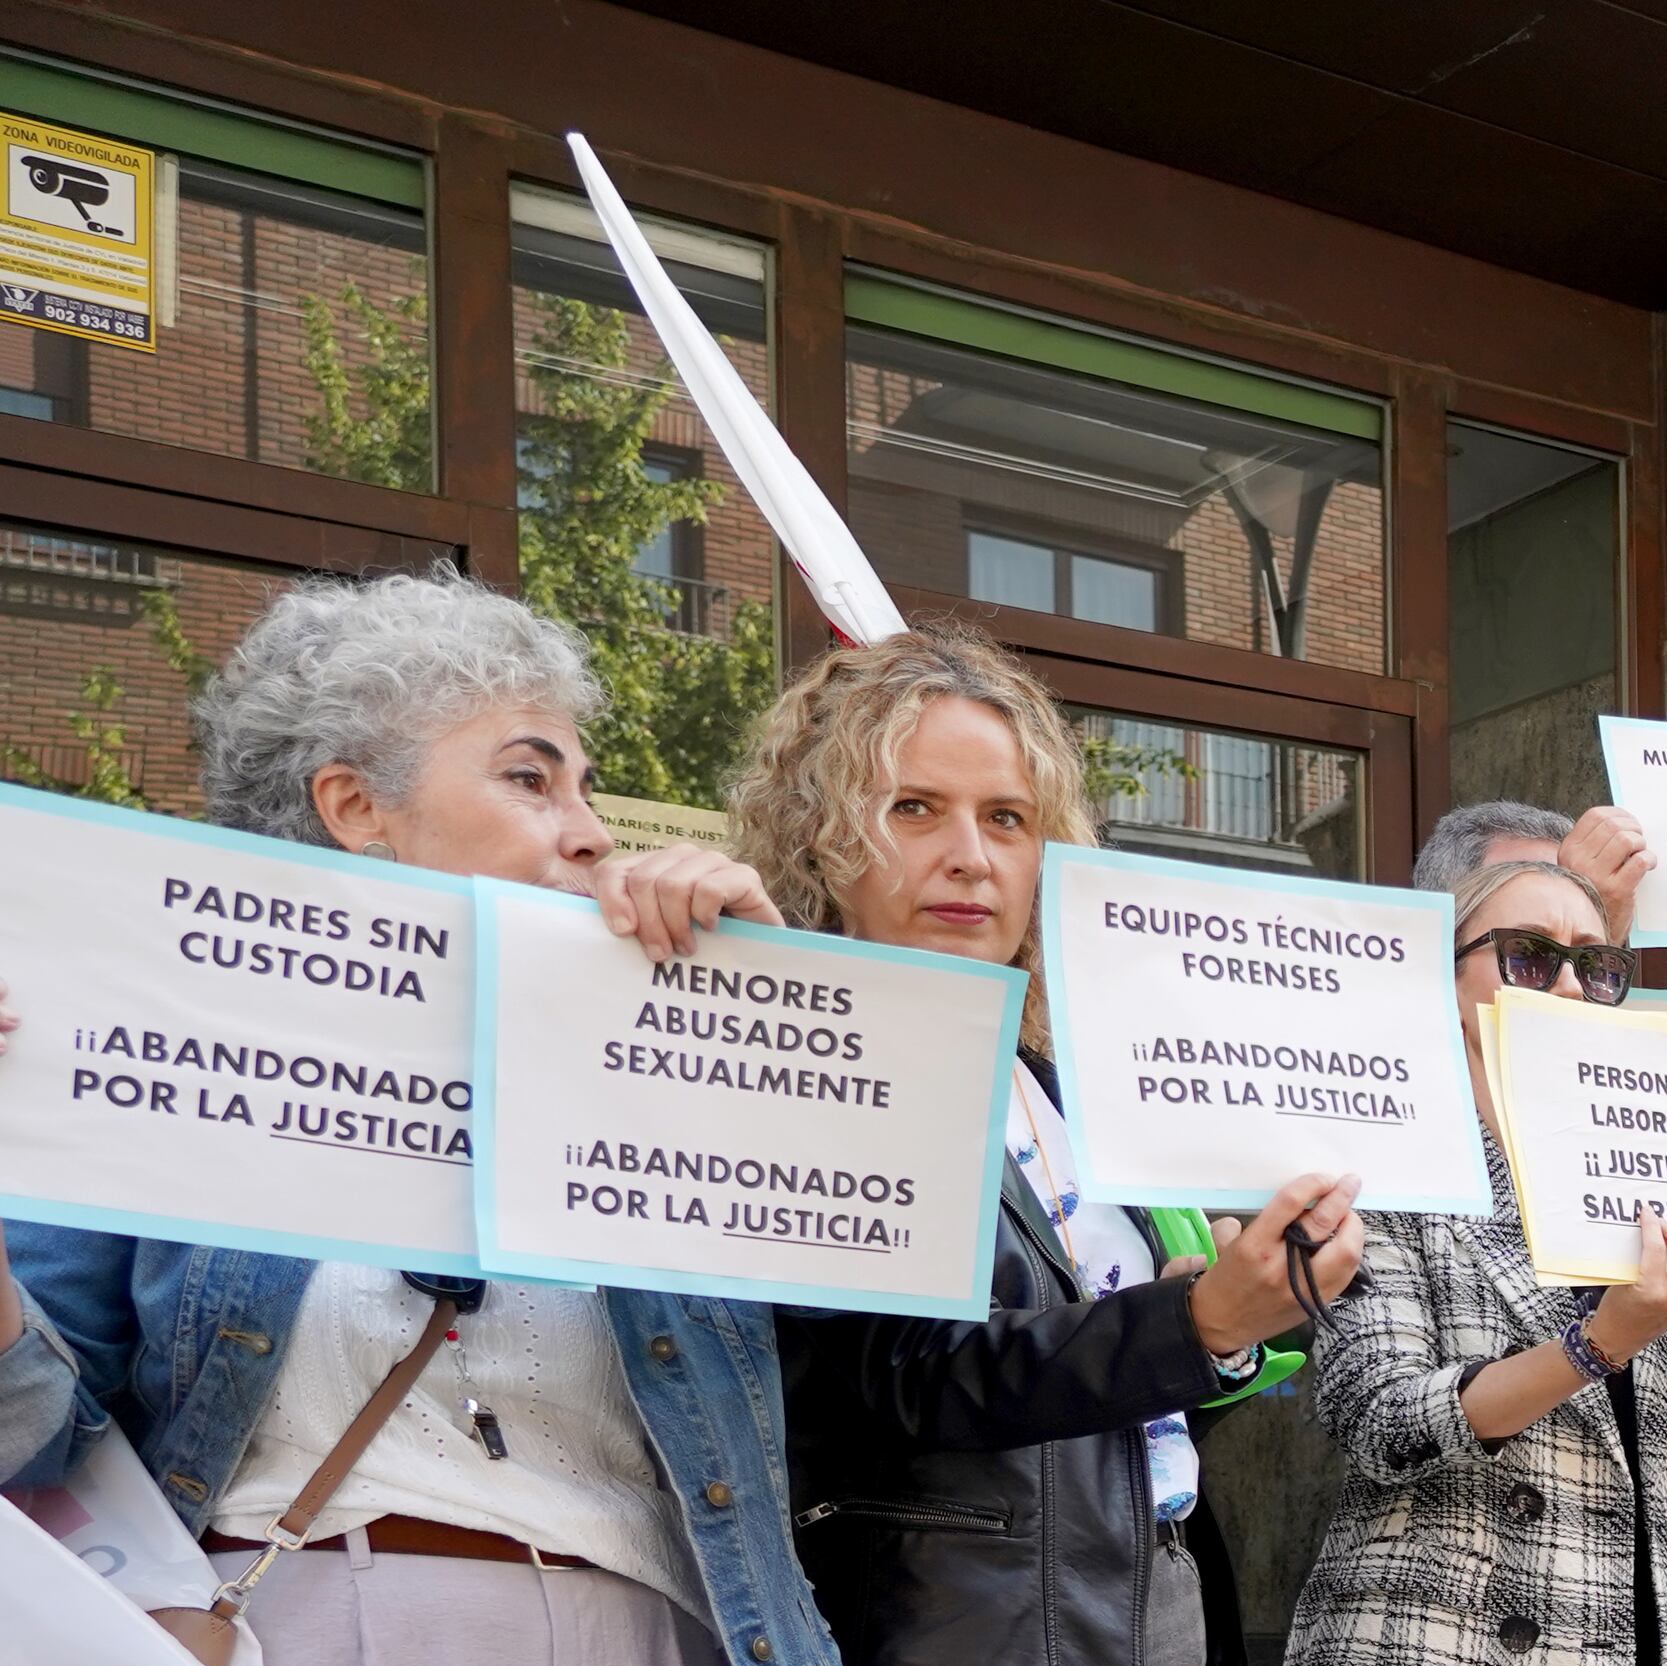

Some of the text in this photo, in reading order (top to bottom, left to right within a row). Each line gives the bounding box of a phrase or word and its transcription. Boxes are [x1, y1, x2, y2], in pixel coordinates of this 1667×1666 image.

[3, 125, 141, 169] ZONA VIDEOVIGILADA
[44, 305, 76, 324] 902
[80, 313, 111, 331] 934
[115, 321, 145, 338] 936
[665, 825, 684, 837] DE
[164, 877, 449, 959] PADRES SIN
[1105, 901, 1405, 963] EQUIPOS TÉCNICOS
[180, 931, 426, 1003] CUSTODIA
[650, 960, 854, 1017] MENORES
[1182, 953, 1340, 993] FORENSES
[635, 1002, 863, 1061] ABUSADOS
[73, 1068, 178, 1115] POR
[198, 1088, 255, 1126] LA
[76, 1026, 473, 1112] ¡¡ABANDONADO
[604, 1041, 891, 1108] SEXUALMENTE
[1138, 1076, 1213, 1104] POR
[1223, 1080, 1263, 1106] LA
[567, 1182, 650, 1219] POR
[665, 1194, 710, 1227] LA
